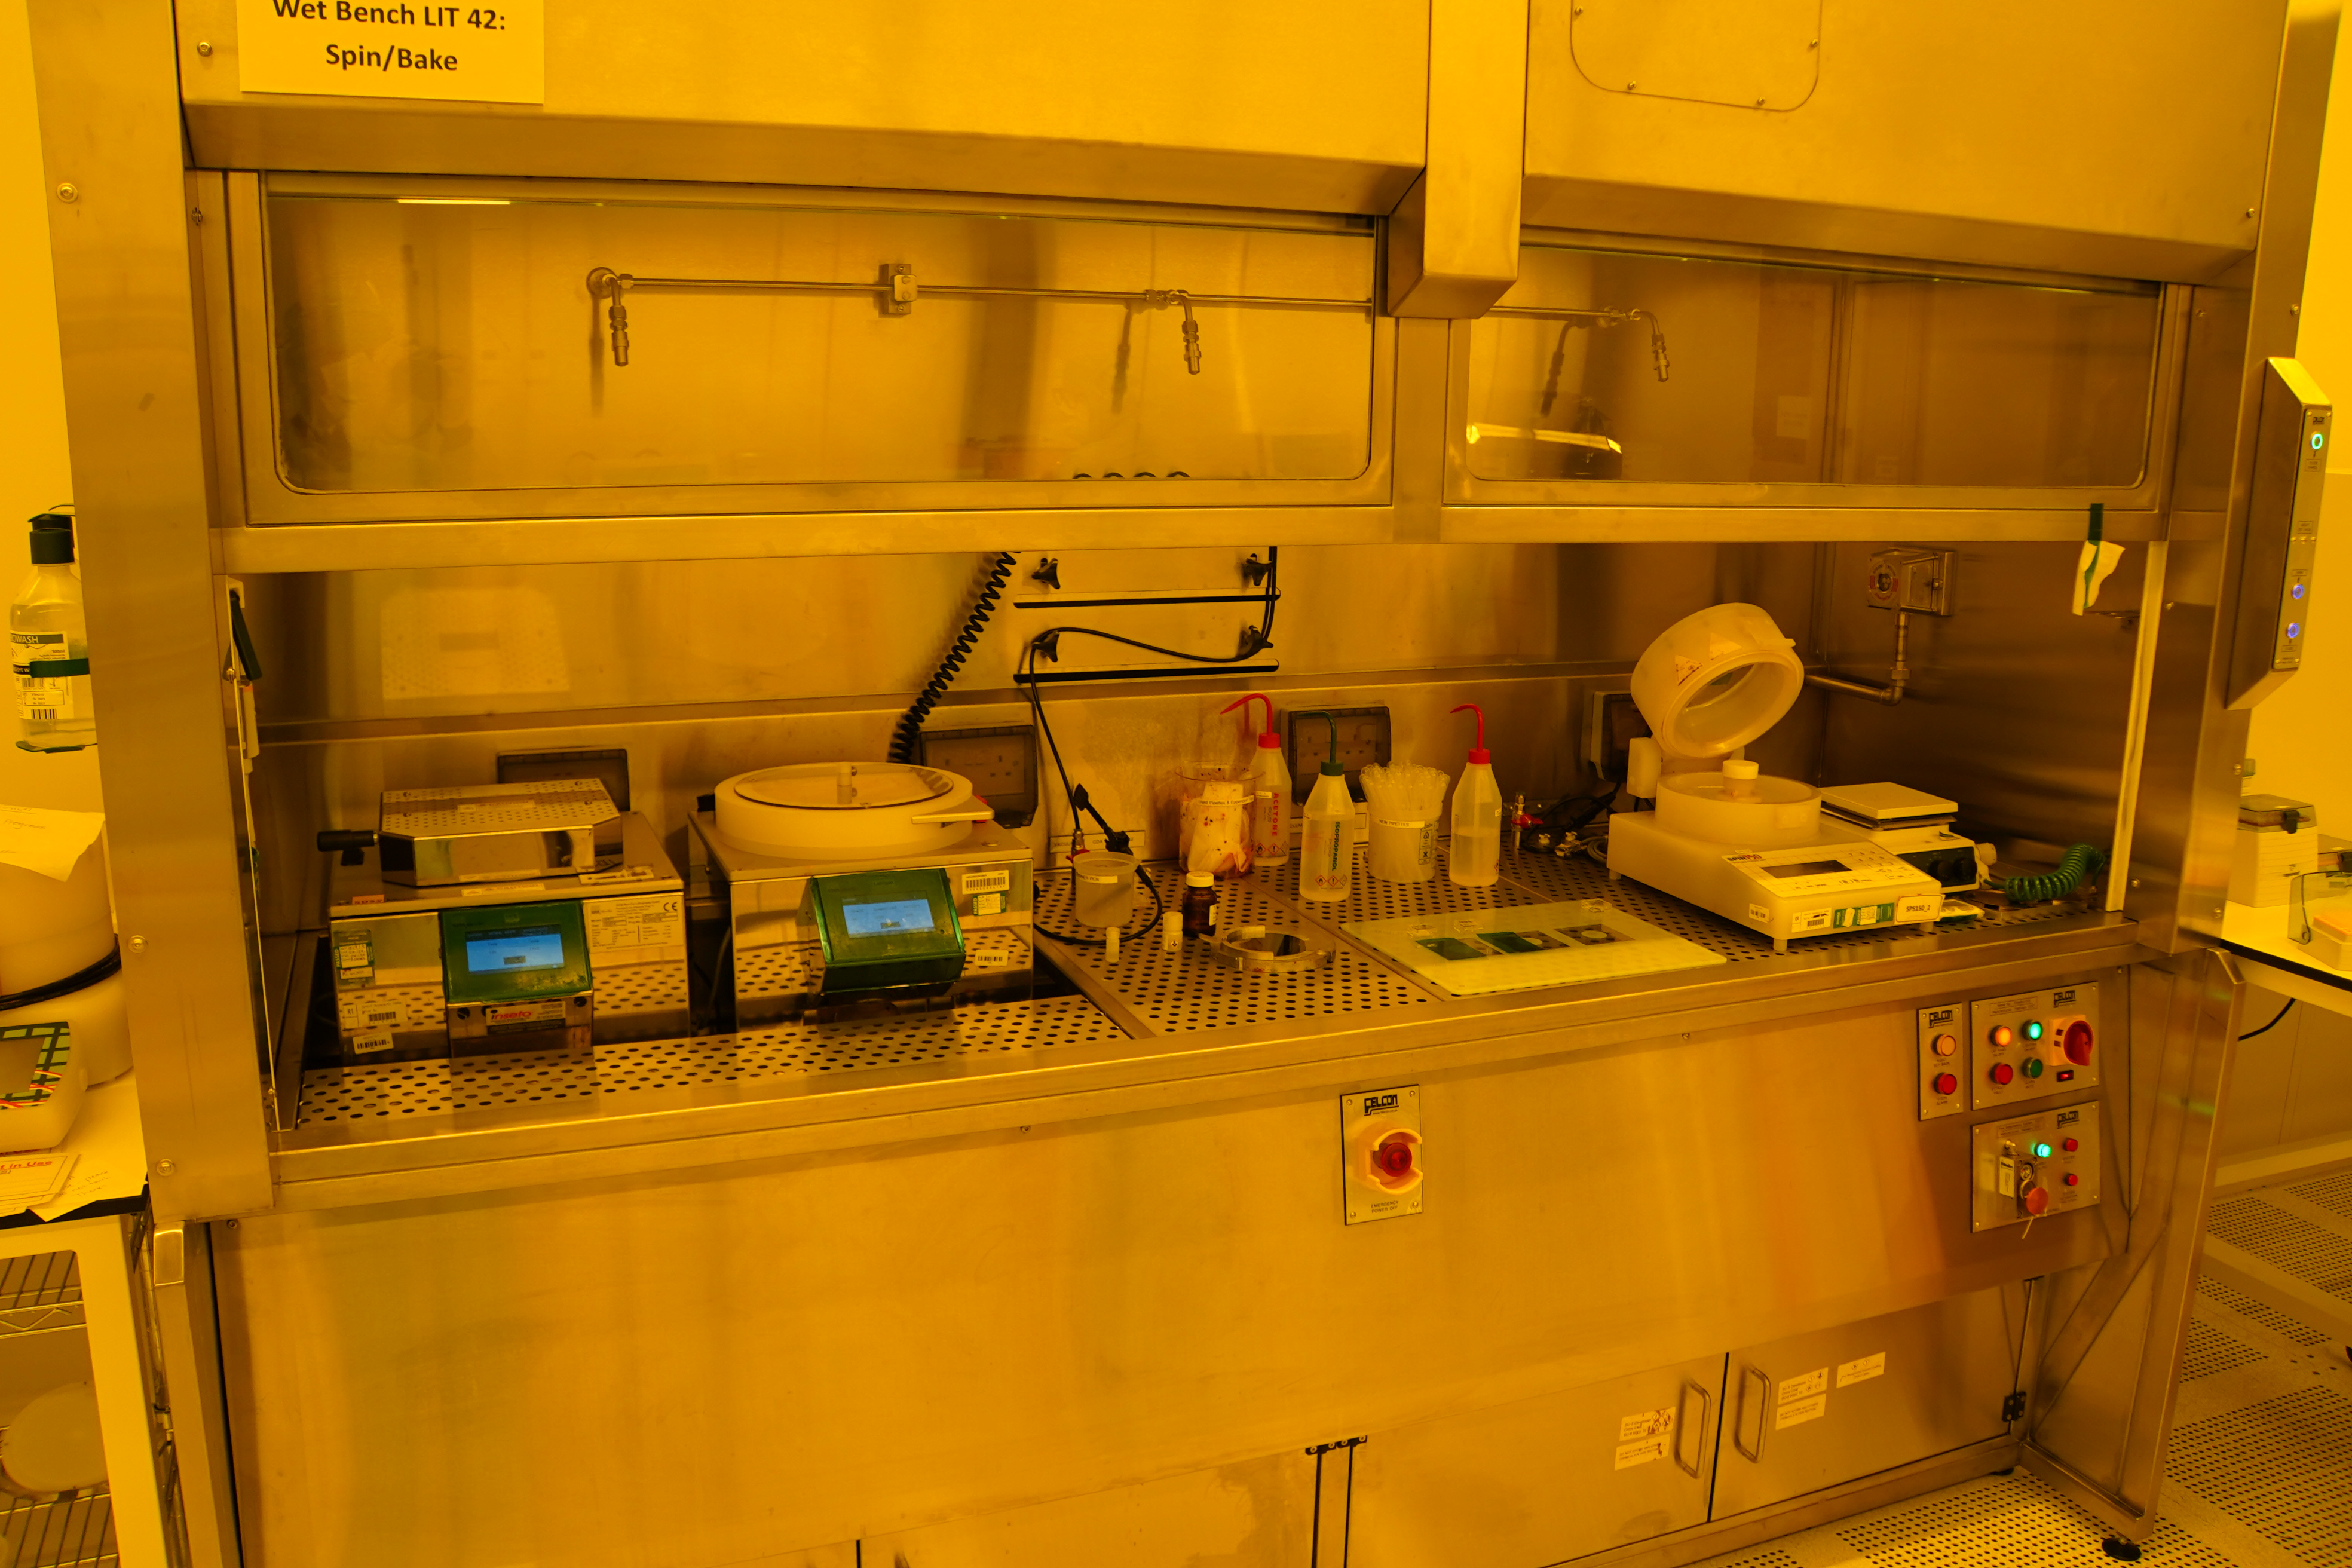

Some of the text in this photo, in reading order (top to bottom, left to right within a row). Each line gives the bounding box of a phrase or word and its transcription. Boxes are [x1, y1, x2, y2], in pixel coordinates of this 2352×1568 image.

[272, 0, 505, 30] Wet Bench LIT 42:
[326, 44, 458, 71] Spin/Bake
[1332, 822, 1340, 872] ISOPROPANOL
[491, 1009, 532, 1020] inseto
[1364, 1094, 1398, 1114] FELCON
